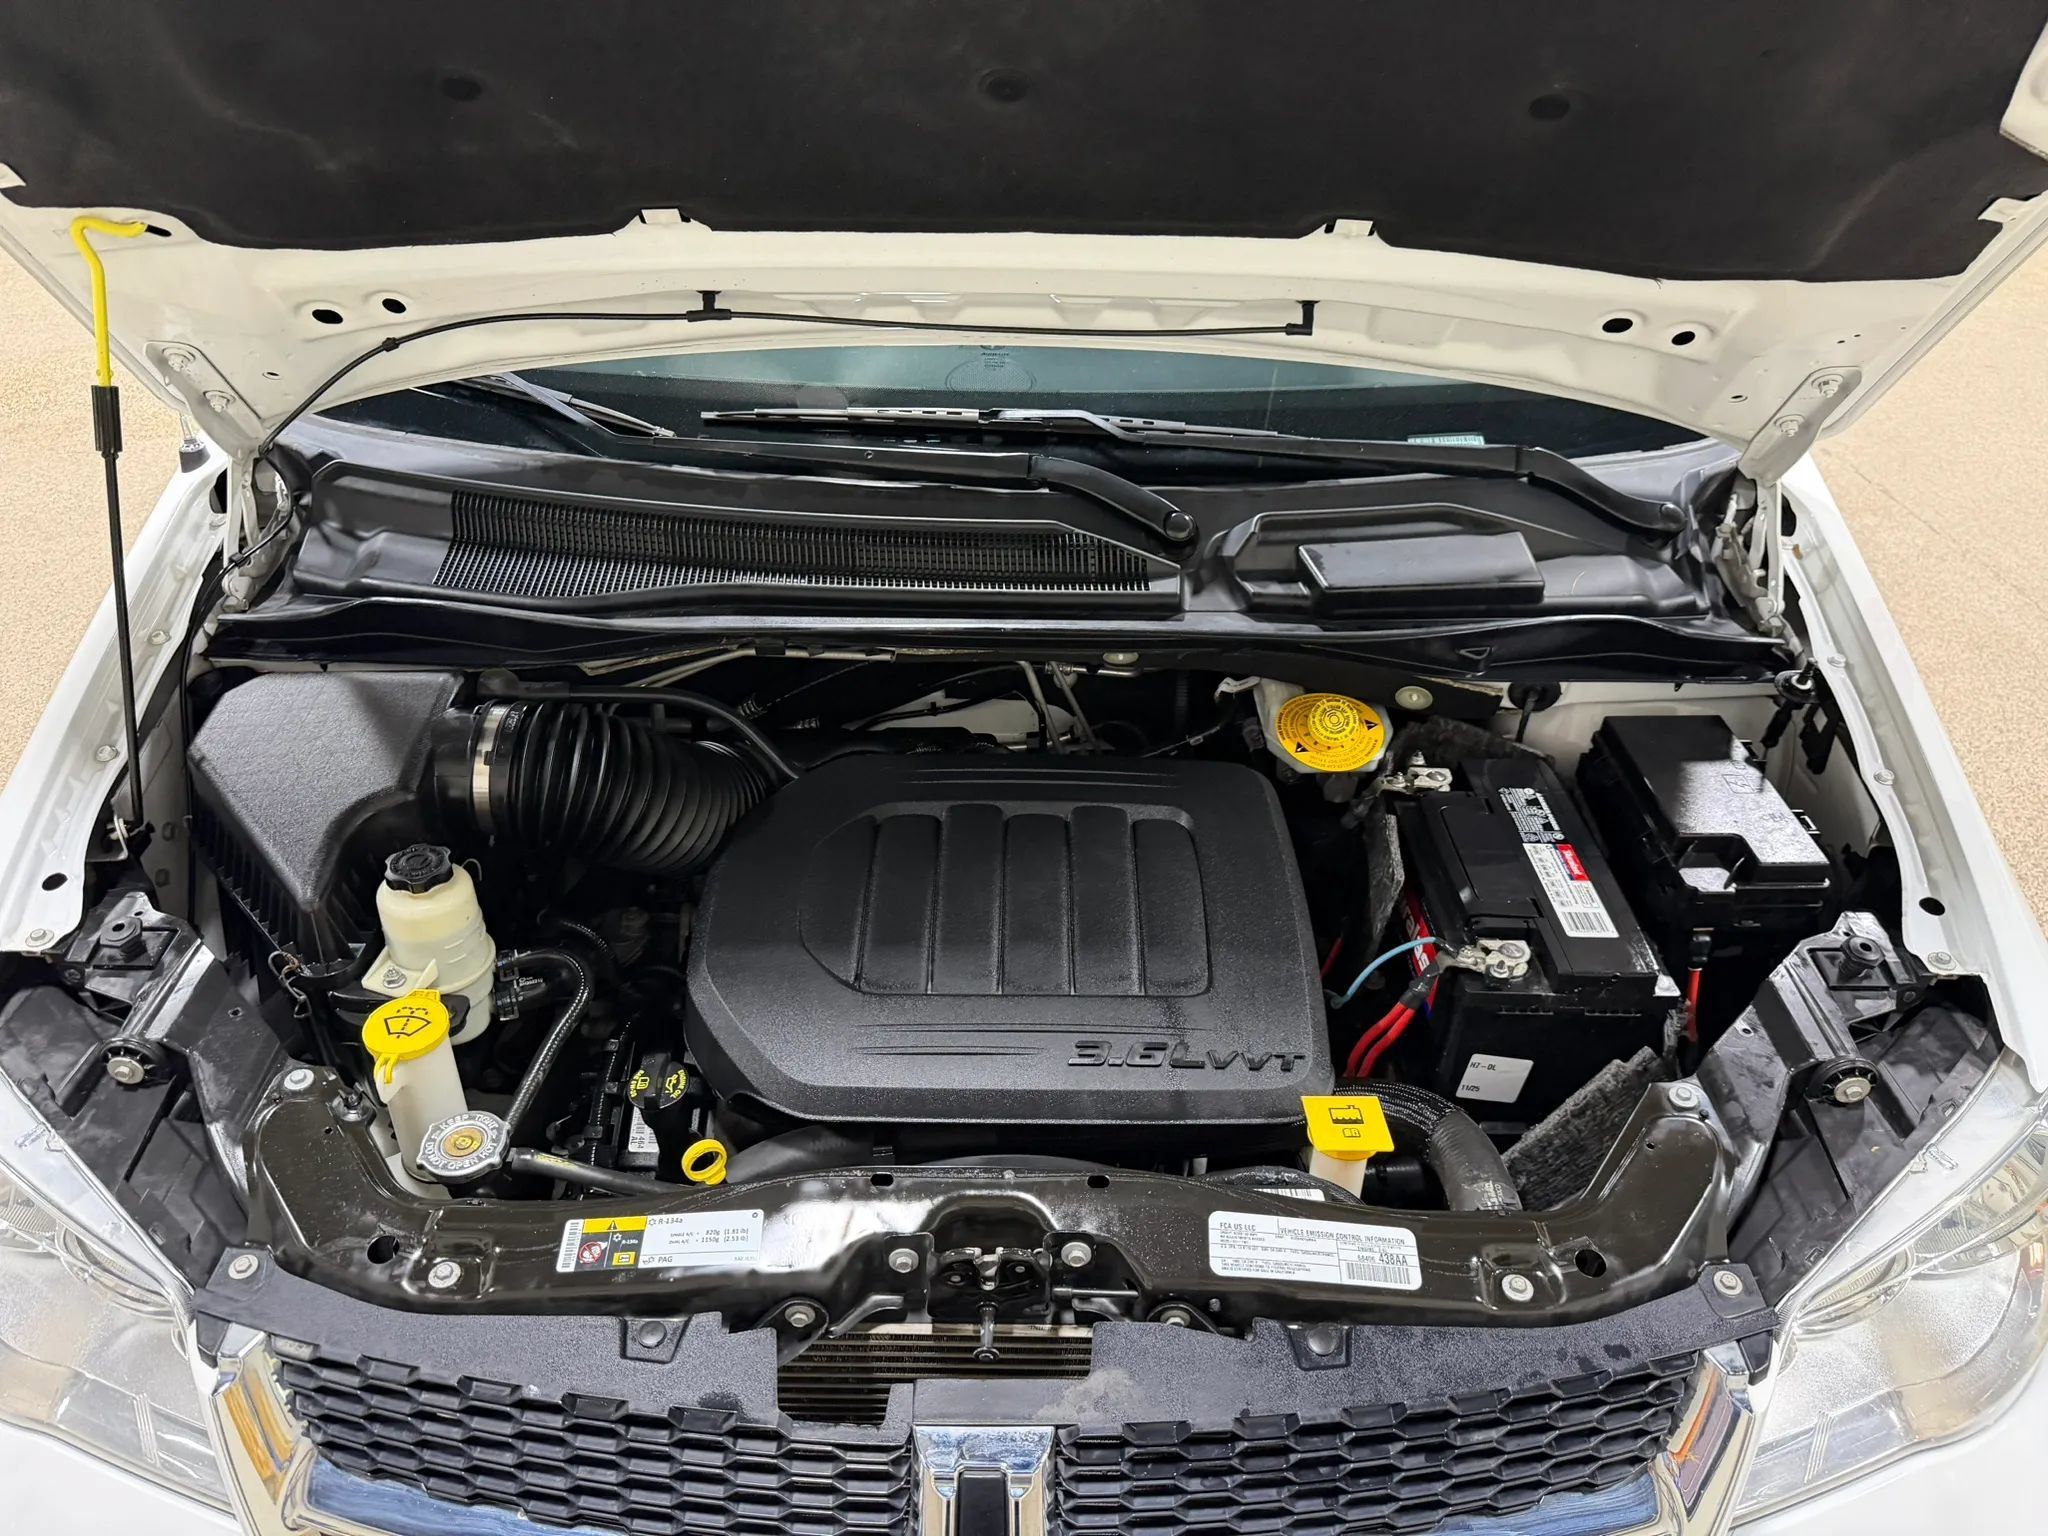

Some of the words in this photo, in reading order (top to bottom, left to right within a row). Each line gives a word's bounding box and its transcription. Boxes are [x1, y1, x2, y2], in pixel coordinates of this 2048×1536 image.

[669, 1089, 682, 1099] OIL
[1461, 1084, 1480, 1092] 11/25
[440, 1113, 469, 1130] KEEP
[475, 1113, 499, 1129] TIGHT
[425, 1142, 435, 1154] DO
[479, 1141, 498, 1159] HOT
[428, 1153, 448, 1168] NOT
[447, 1156, 479, 1170] OPEN
[658, 1217, 683, 1225] R-134a
[1220, 1222, 1232, 1230] FCA
[1233, 1223, 1243, 1231] US
[1244, 1224, 1256, 1232] LLC
[1279, 1228, 1304, 1237] VEHICLE
[1305, 1230, 1335, 1240] EMISSION
[1336, 1233, 1362, 1242] CONTROL
[1364, 1236, 1405, 1246] INFORMATION
[658, 1256, 673, 1264] PAG
[1378, 1252, 1408, 1266] 438AA
